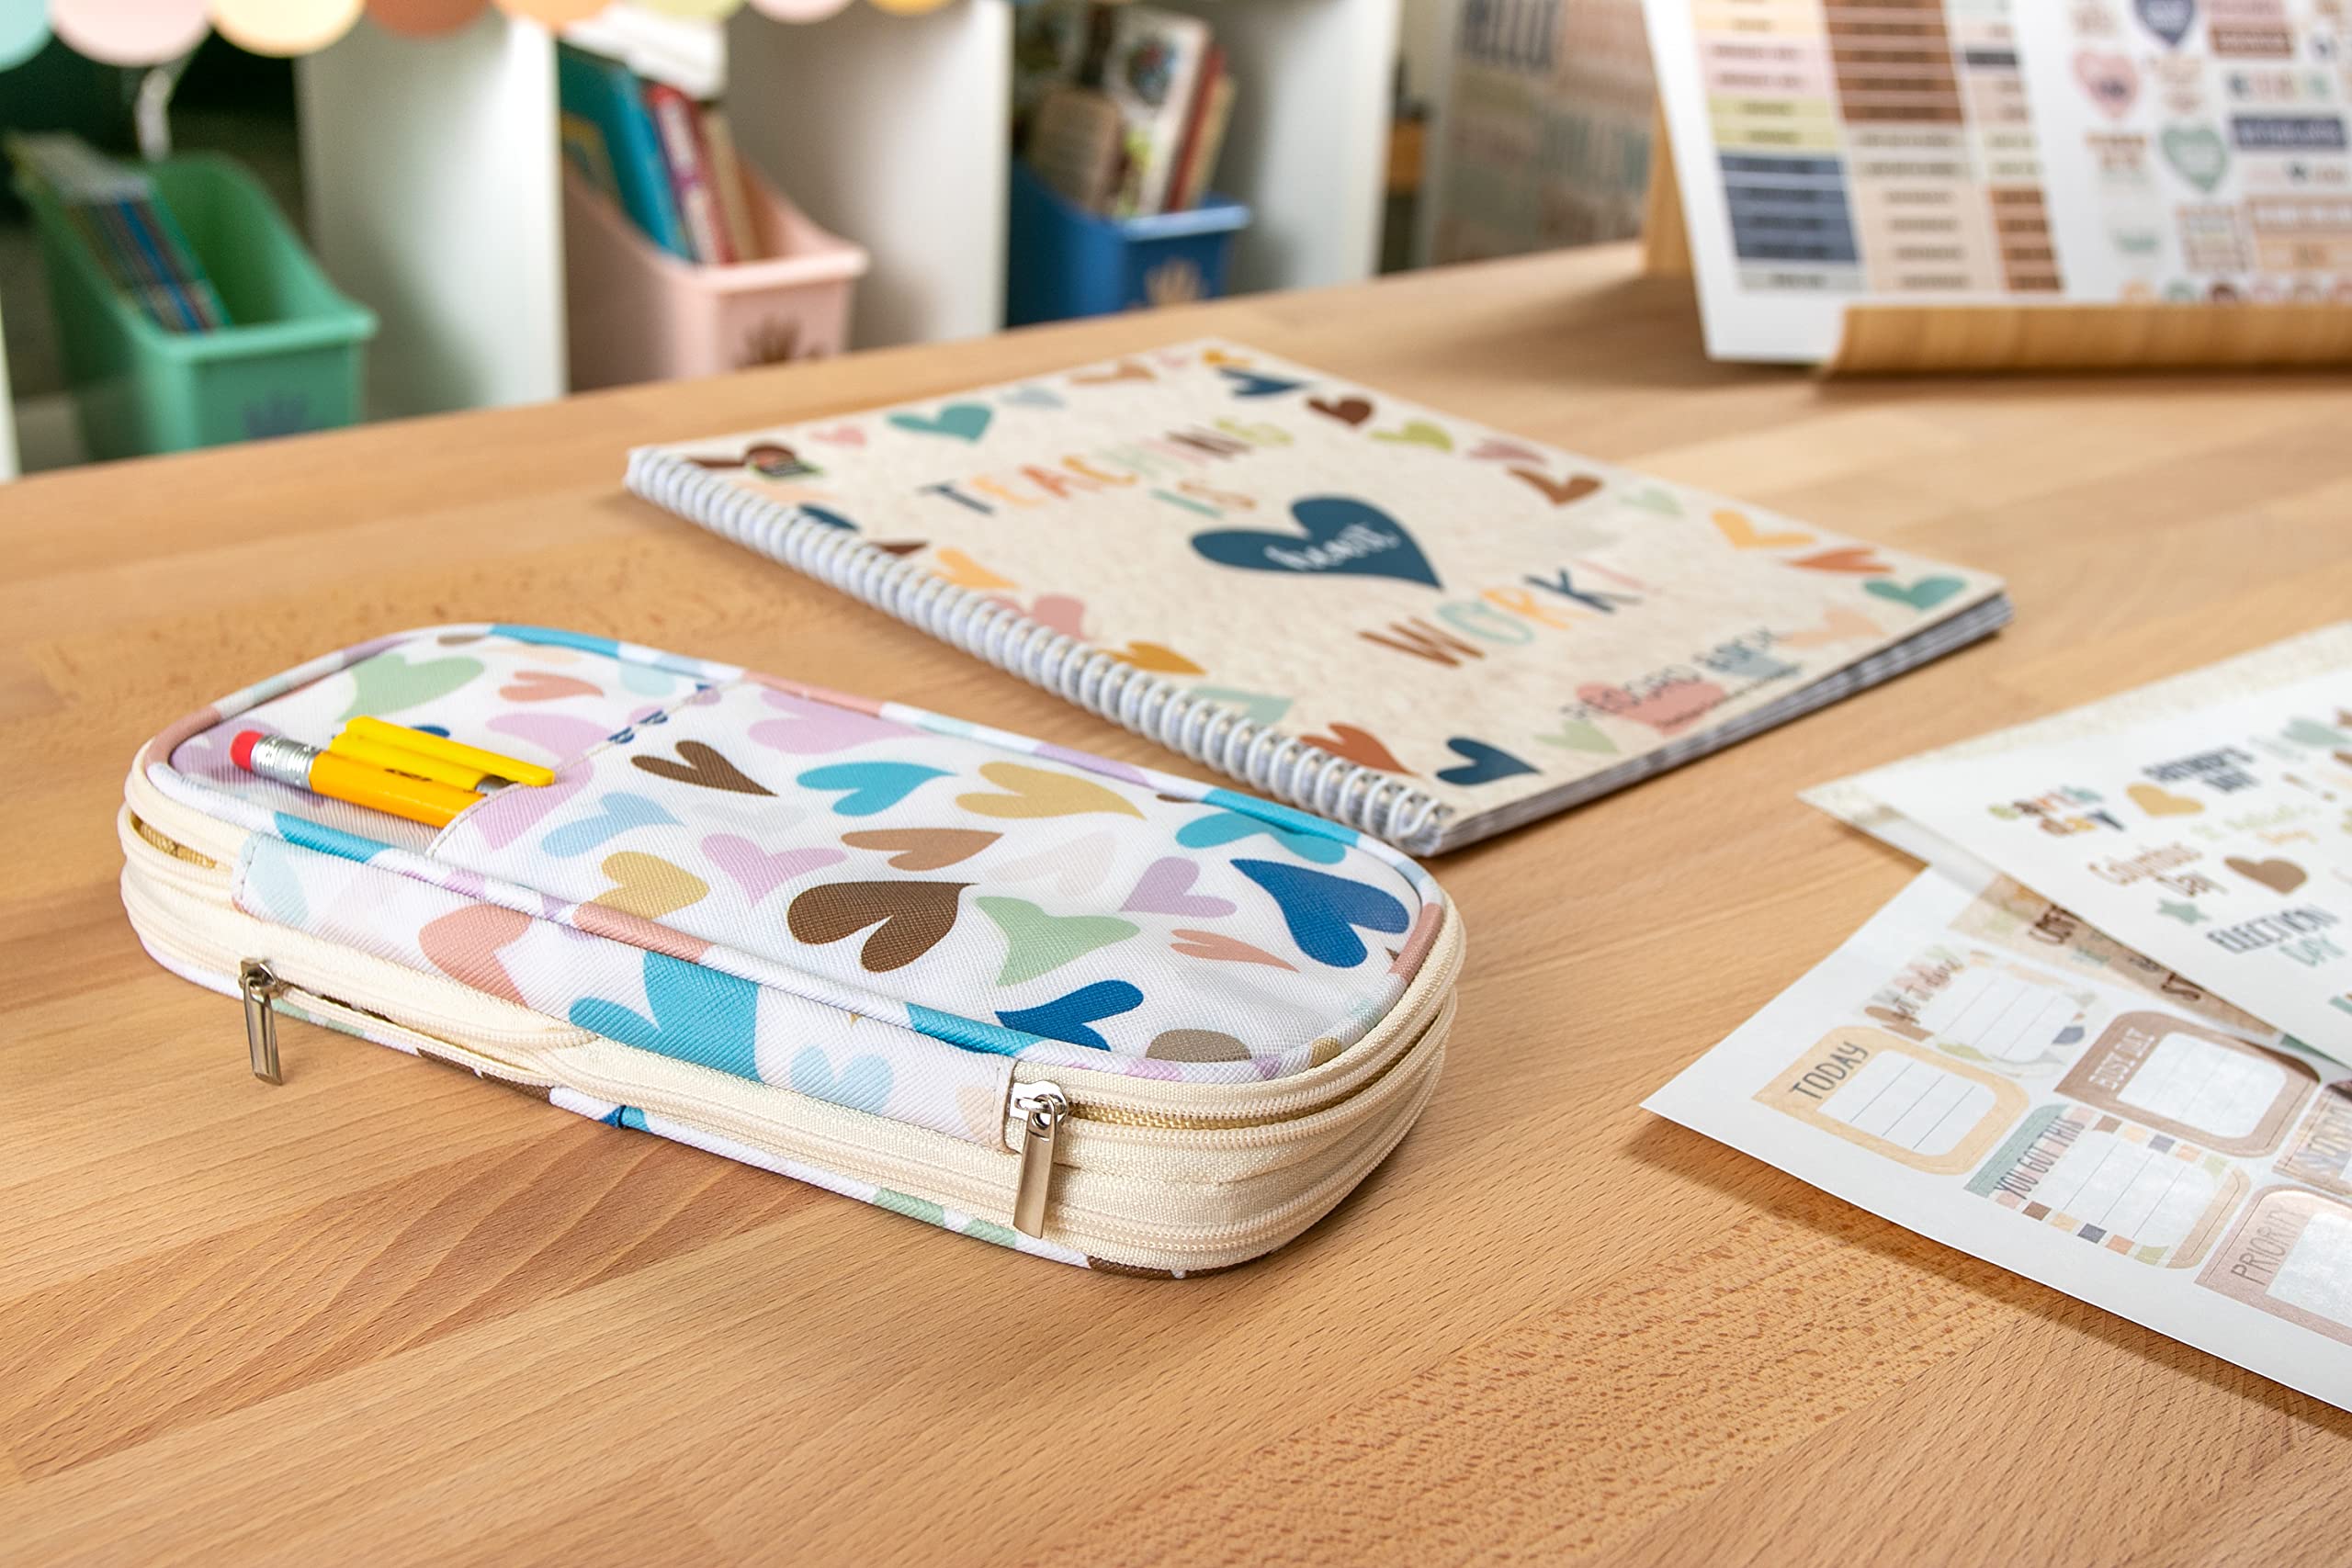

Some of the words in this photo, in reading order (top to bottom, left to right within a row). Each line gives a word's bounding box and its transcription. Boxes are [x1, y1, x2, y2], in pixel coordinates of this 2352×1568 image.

[916, 417, 1294, 516] TEACHING
[1150, 479, 1259, 519] IS
[1356, 558, 1663, 668] WORK!
[2206, 905, 2342, 954] ELECTION
[1788, 1040, 1870, 1100] TODAY
[2087, 1052, 2137, 1091] BUSY
[2115, 1026, 2156, 1059] DAY
[2017, 1142, 2061, 1174] GOT
[2036, 1115, 2086, 1148] THIS
[1993, 1168, 2039, 1201] YOU
[2230, 1205, 2310, 1287] PRIORITY
